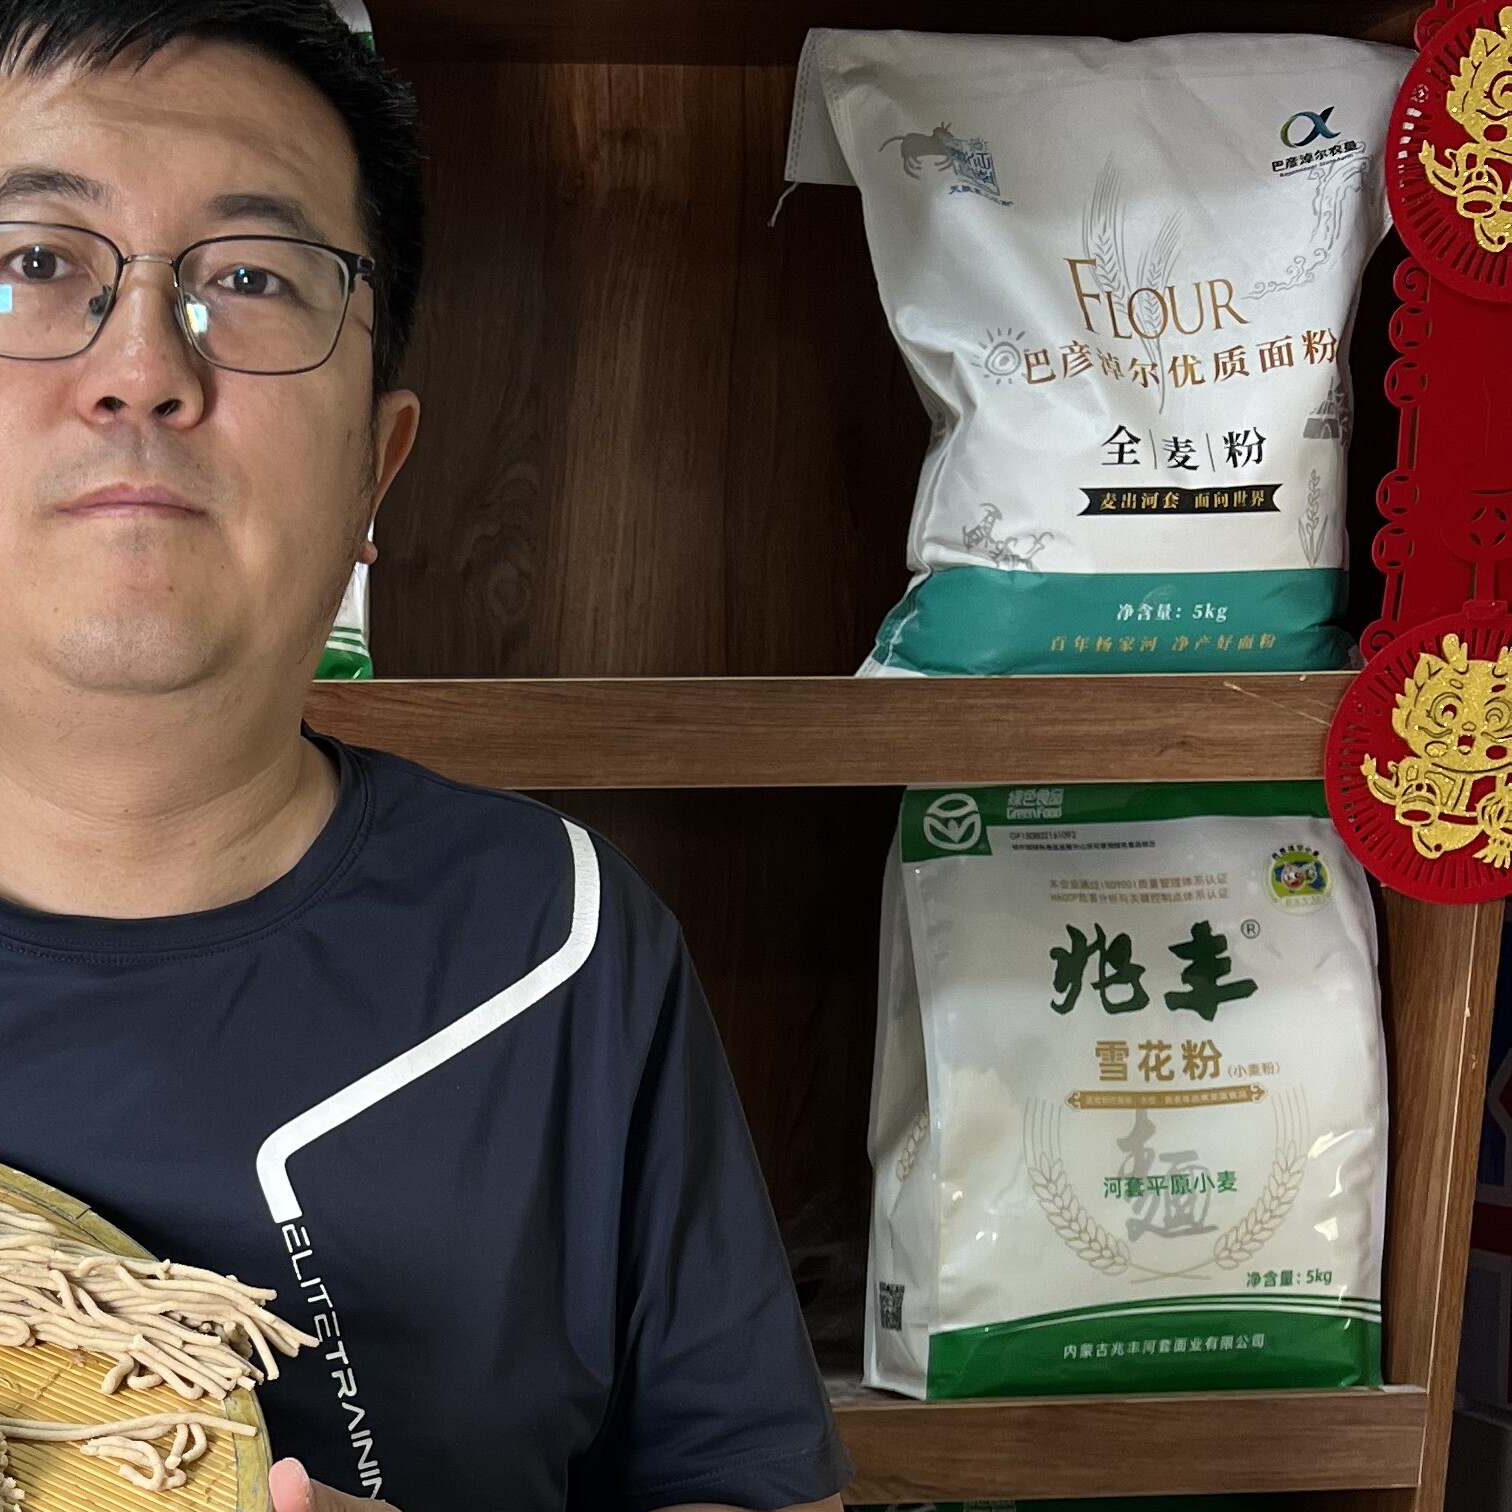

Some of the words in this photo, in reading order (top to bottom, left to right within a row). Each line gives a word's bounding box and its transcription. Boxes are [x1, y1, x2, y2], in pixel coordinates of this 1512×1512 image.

[1062, 257, 1252, 340] FLOUR
[1023, 327, 1338, 388] 巴彦淖尔优质面粉
[1099, 492, 1180, 511] 麦出河套
[1193, 490, 1267, 509] 面向世界
[1192, 602, 1229, 623] 5kg
[1094, 1038, 1223, 1082] 雪花粉
[1102, 1169, 1238, 1199] 河套平原小麦
